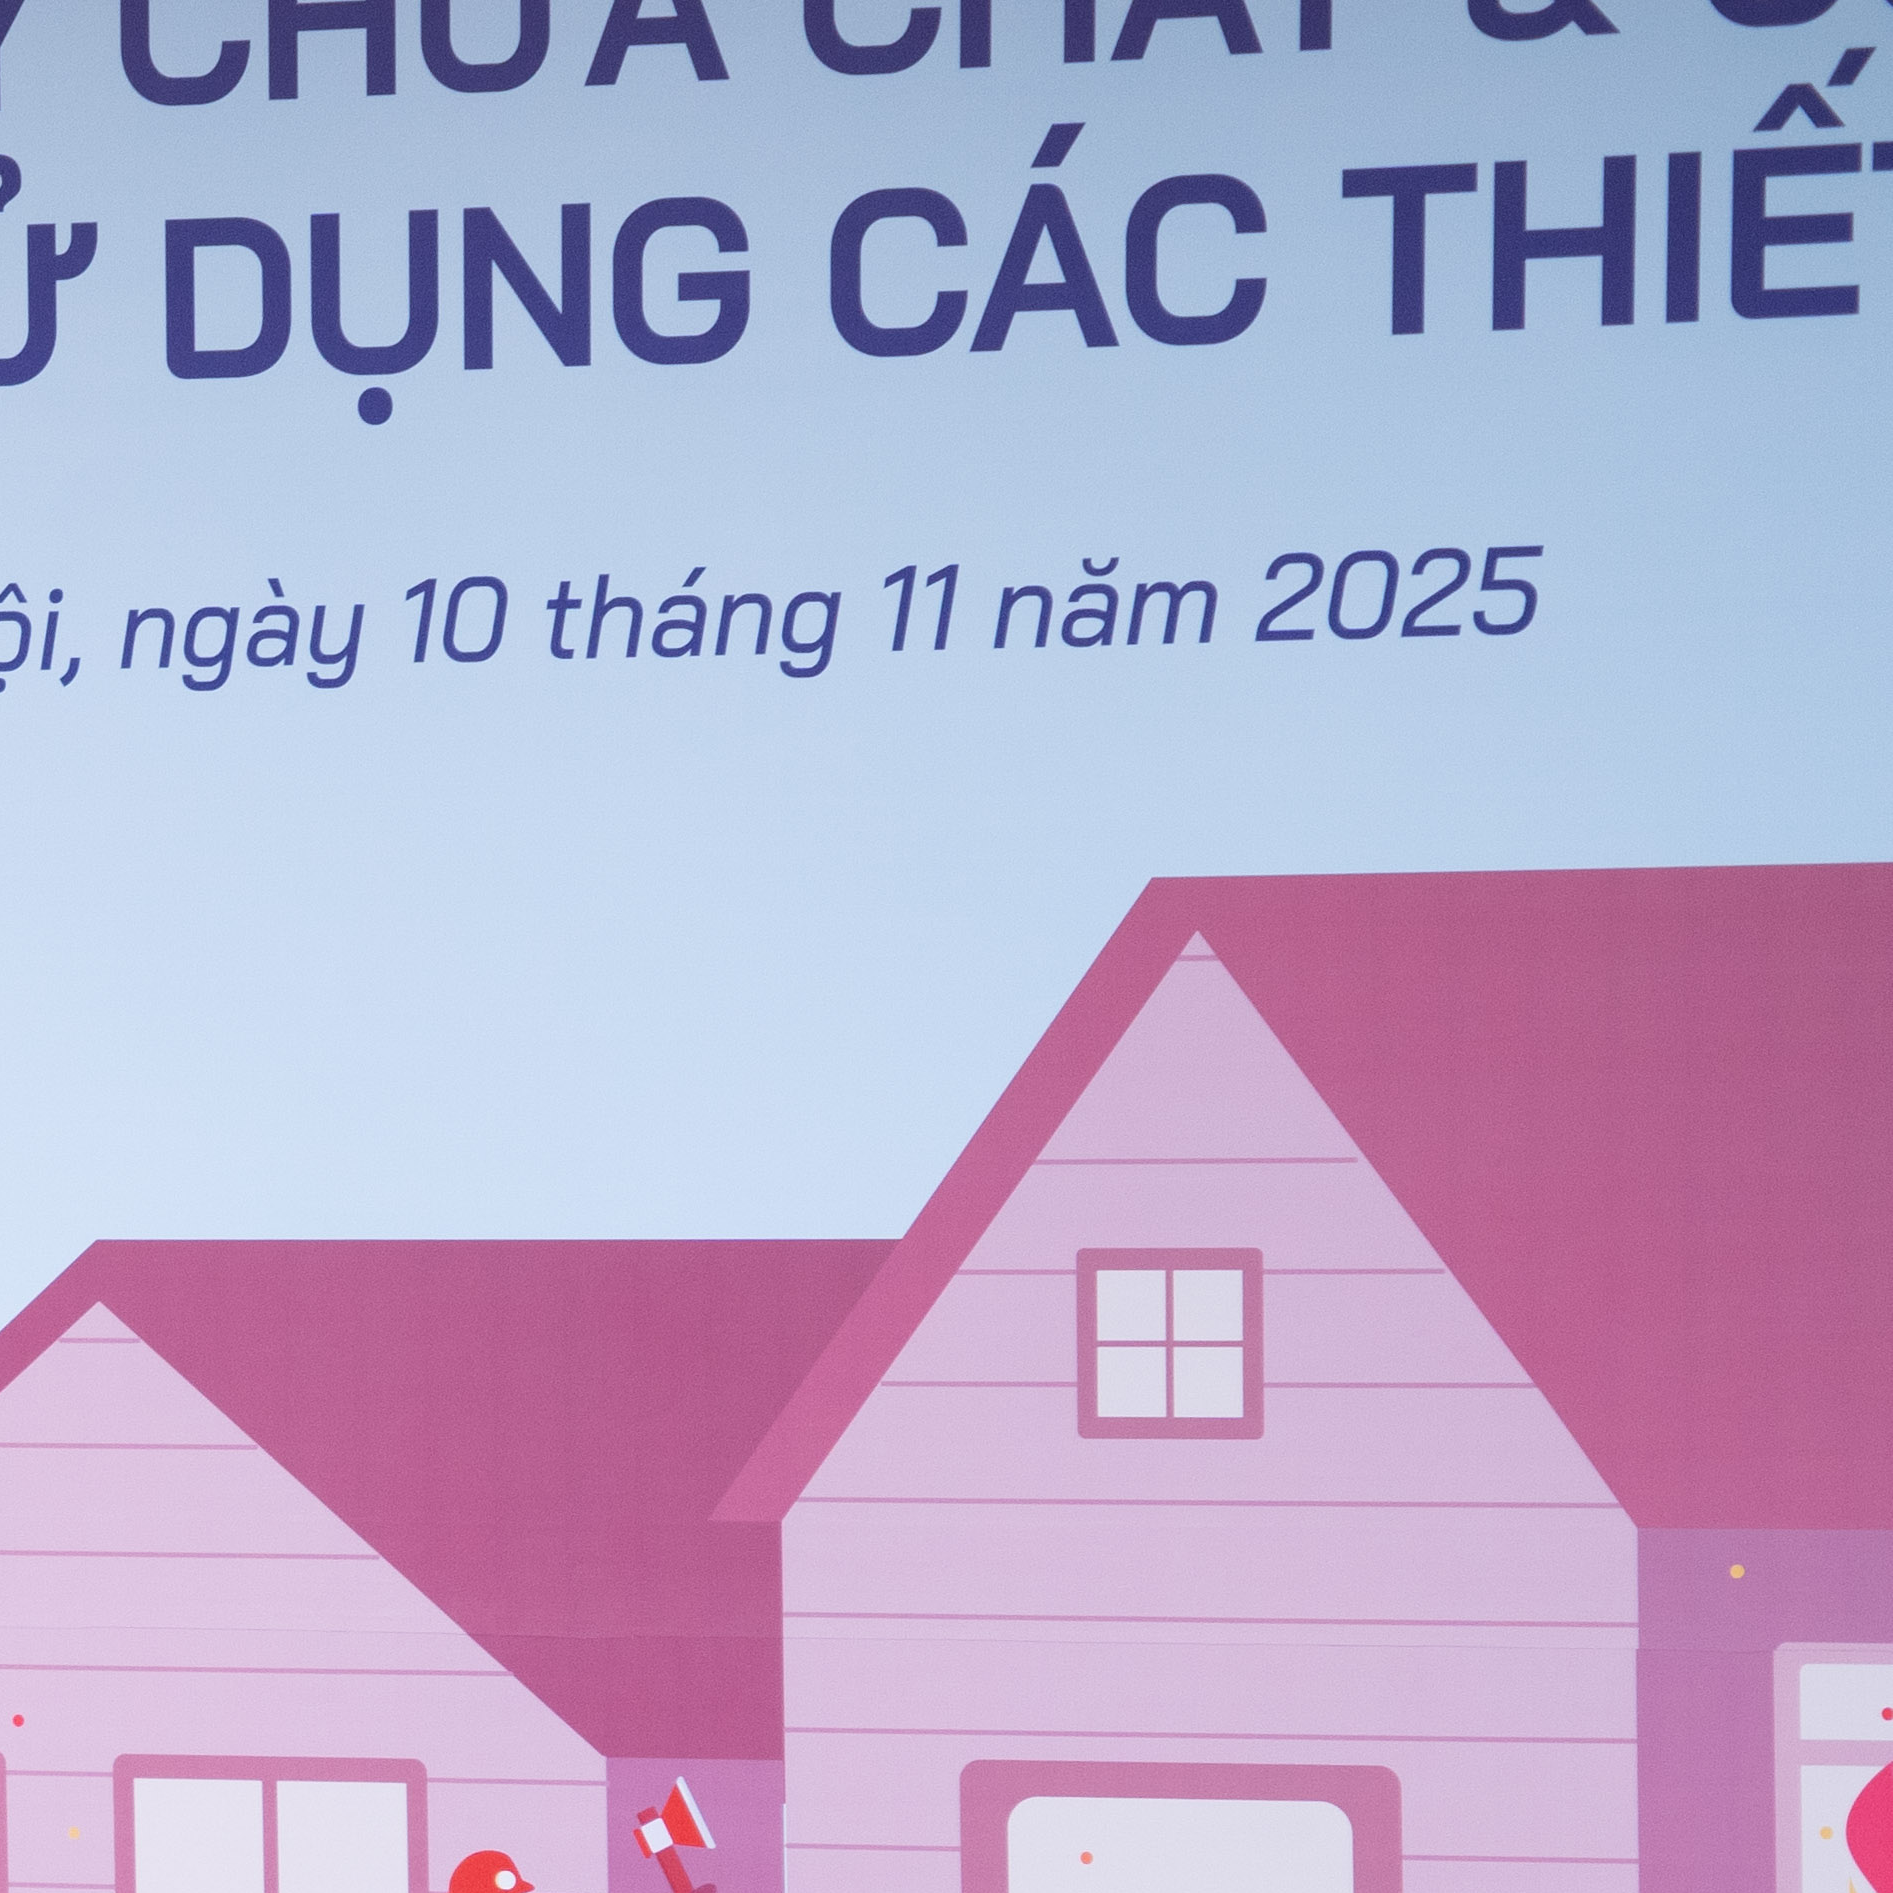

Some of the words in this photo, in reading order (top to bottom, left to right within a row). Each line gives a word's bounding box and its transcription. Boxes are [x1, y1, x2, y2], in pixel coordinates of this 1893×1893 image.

[165, 197, 750, 425] DỤNG
[831, 122, 1266, 357] CÁC
[1342, 47, 1893, 335] THIẾ
[121, 579, 364, 691] ngày
[406, 577, 507, 662] 10
[547, 567, 841, 678] tháng
[885, 565, 958, 651] 11
[994, 558, 1217, 648] năm
[1256, 546, 1543, 641] 2025
